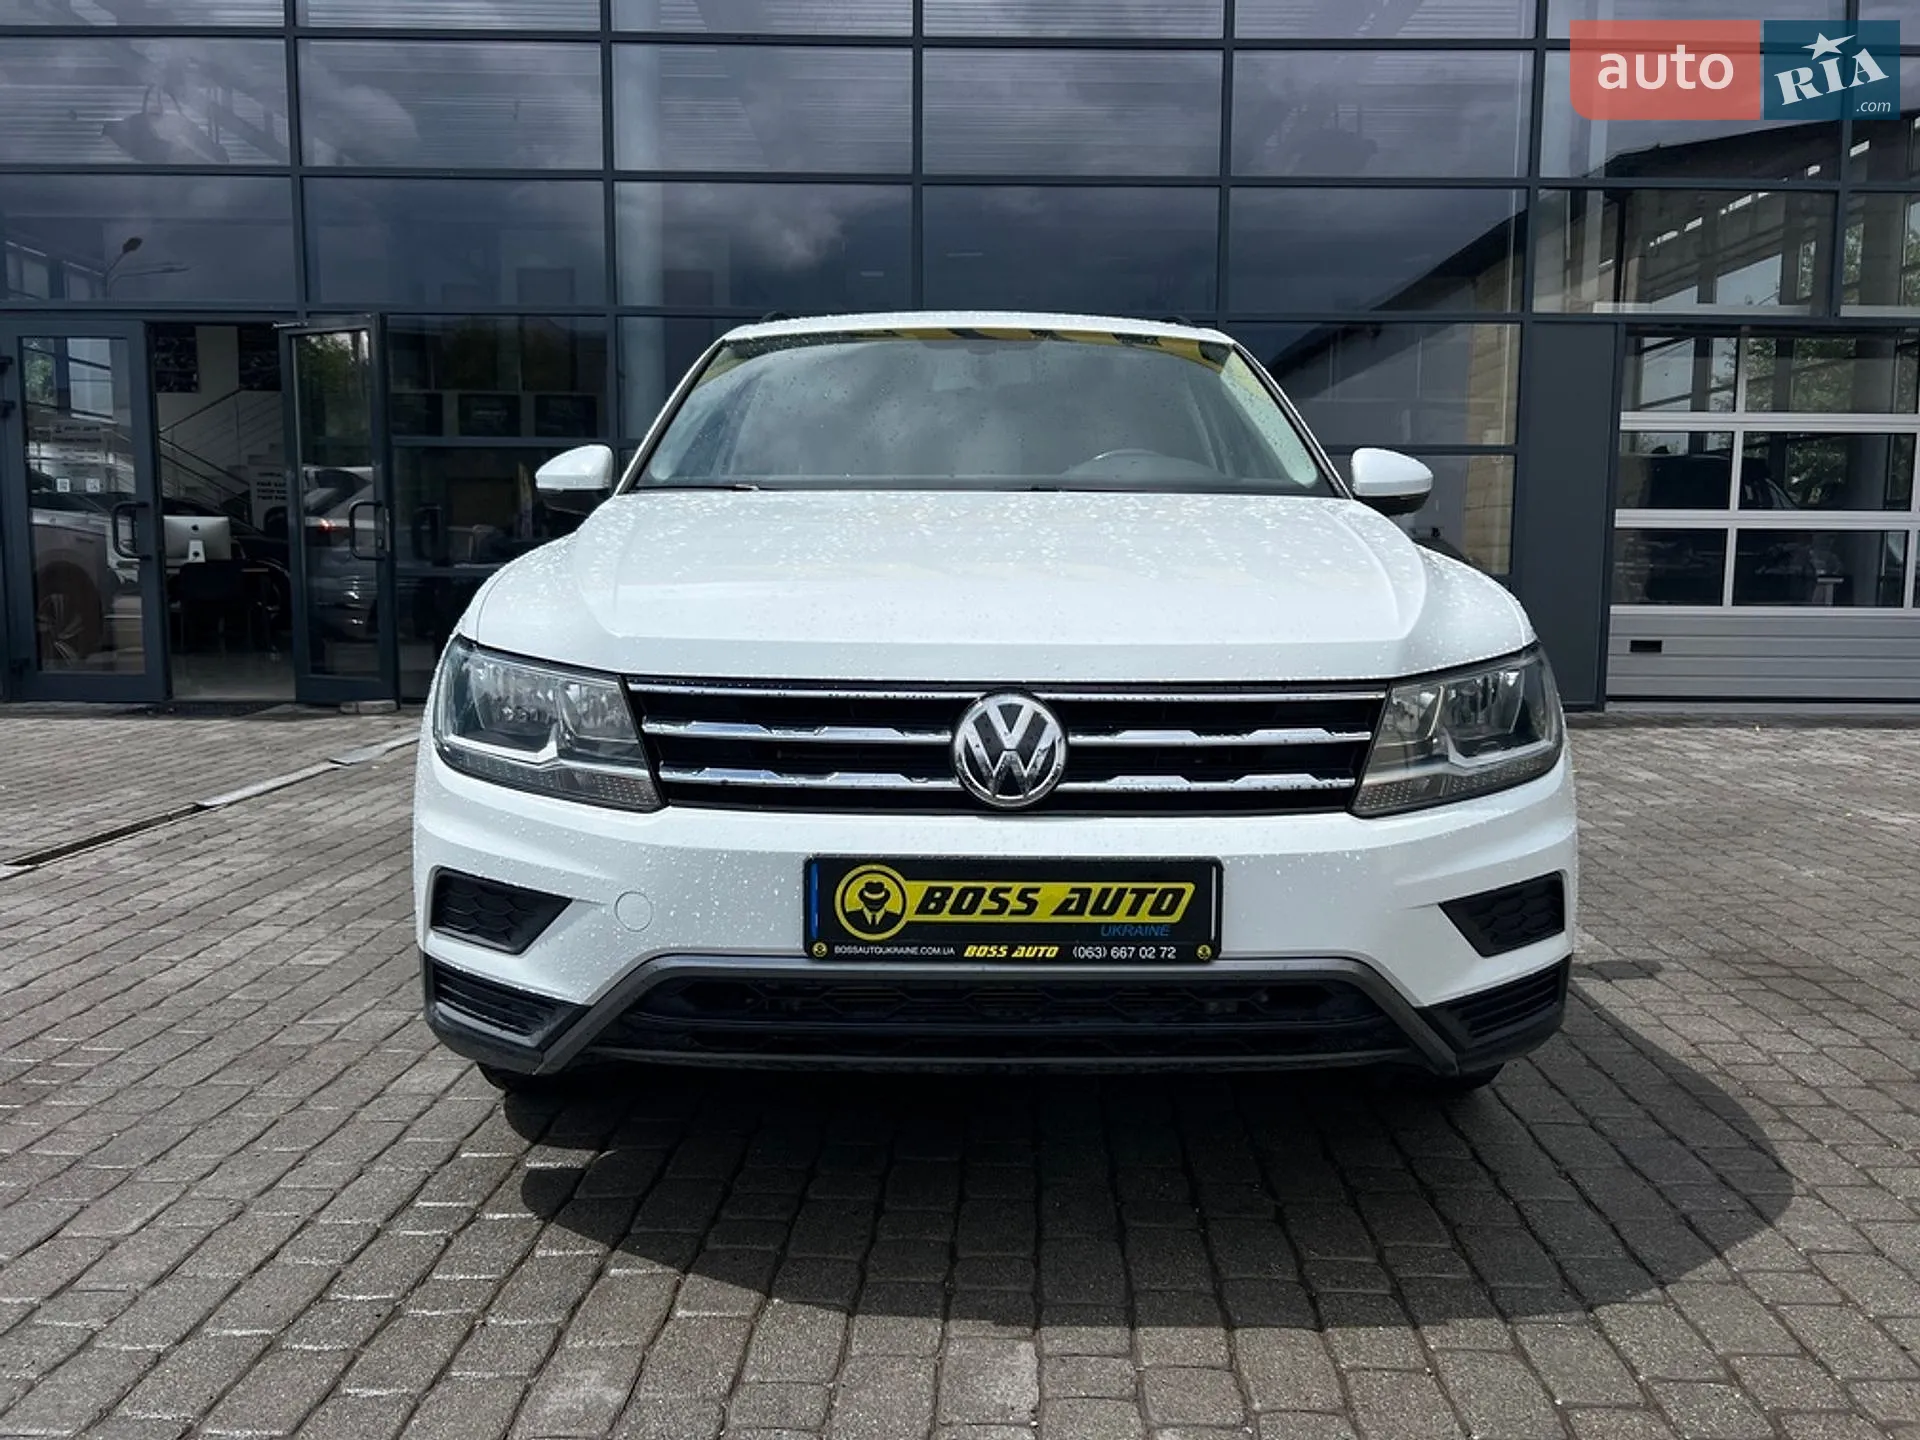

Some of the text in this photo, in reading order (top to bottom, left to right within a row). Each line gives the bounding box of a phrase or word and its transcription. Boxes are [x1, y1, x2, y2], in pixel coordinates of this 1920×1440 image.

[915, 885, 1186, 918] BOSS AUTO
[1100, 924, 1172, 937] UKRAINE
[834, 945, 956, 956] BOSSAUTOUKRAINE.COM.UA
[963, 944, 1060, 959] BOSS AUTO
[1072, 945, 1177, 960] (063) 667 02 72
